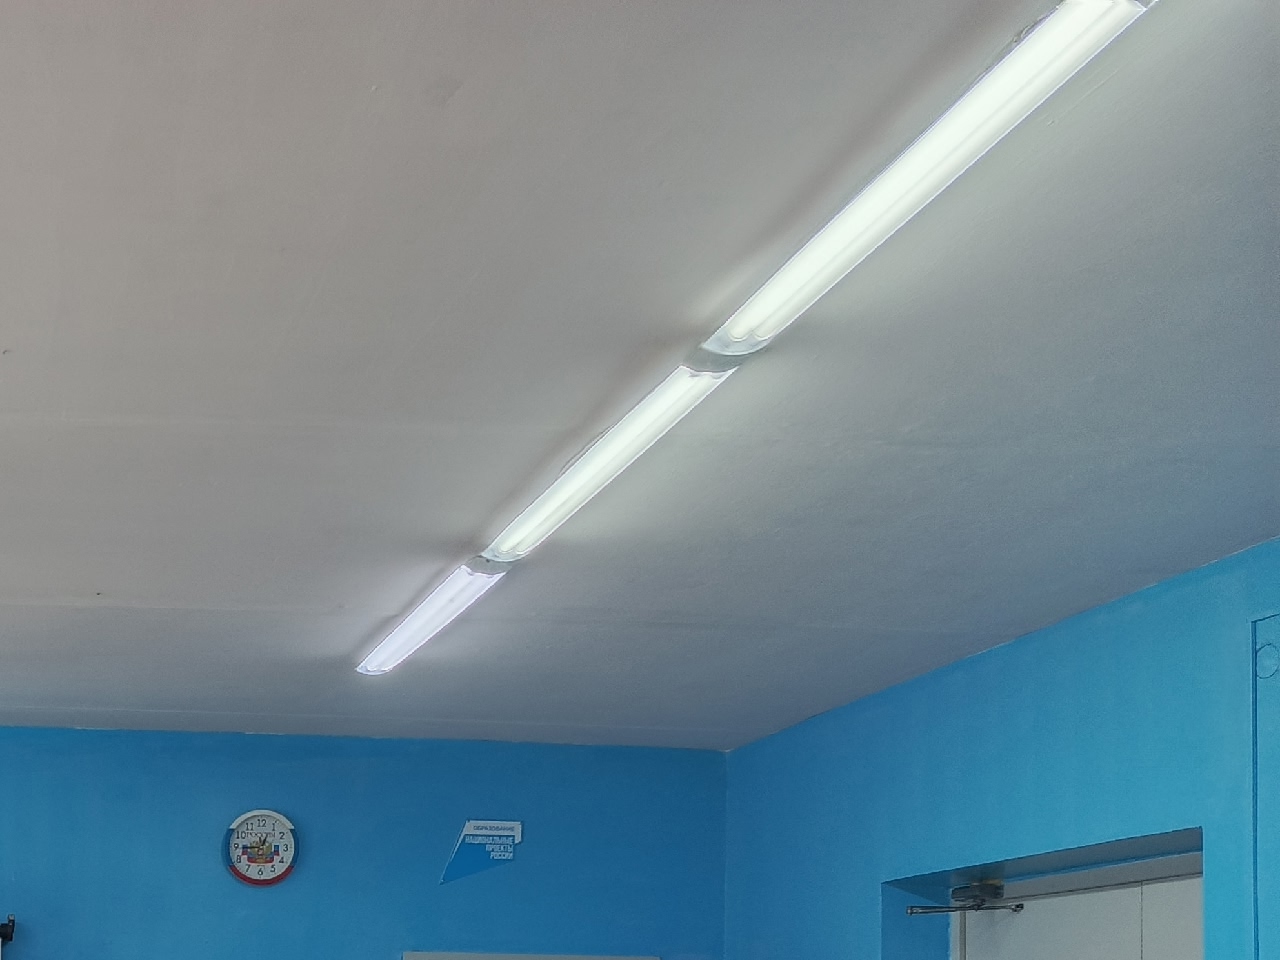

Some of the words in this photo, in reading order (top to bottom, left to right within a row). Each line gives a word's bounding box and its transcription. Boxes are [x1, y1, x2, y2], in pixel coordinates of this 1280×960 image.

[245, 822, 254, 831] 11
[256, 818, 267, 828] 12
[272, 822, 276, 831] 1
[236, 831, 246, 840] 10
[279, 831, 285, 840] 2
[464, 834, 514, 845] НАЦИОНАЛЬНЫЕ
[233, 843, 239, 851] 9
[283, 843, 289, 852] 3
[486, 844, 514, 852] ПРОЕКТЫ
[236, 855, 242, 864] 8
[278, 856, 285, 864] 4
[490, 851, 514, 860] РОССИИ
[245, 864, 251, 873] 7
[257, 868, 264, 876] 6
[269, 864, 276, 873] 5
